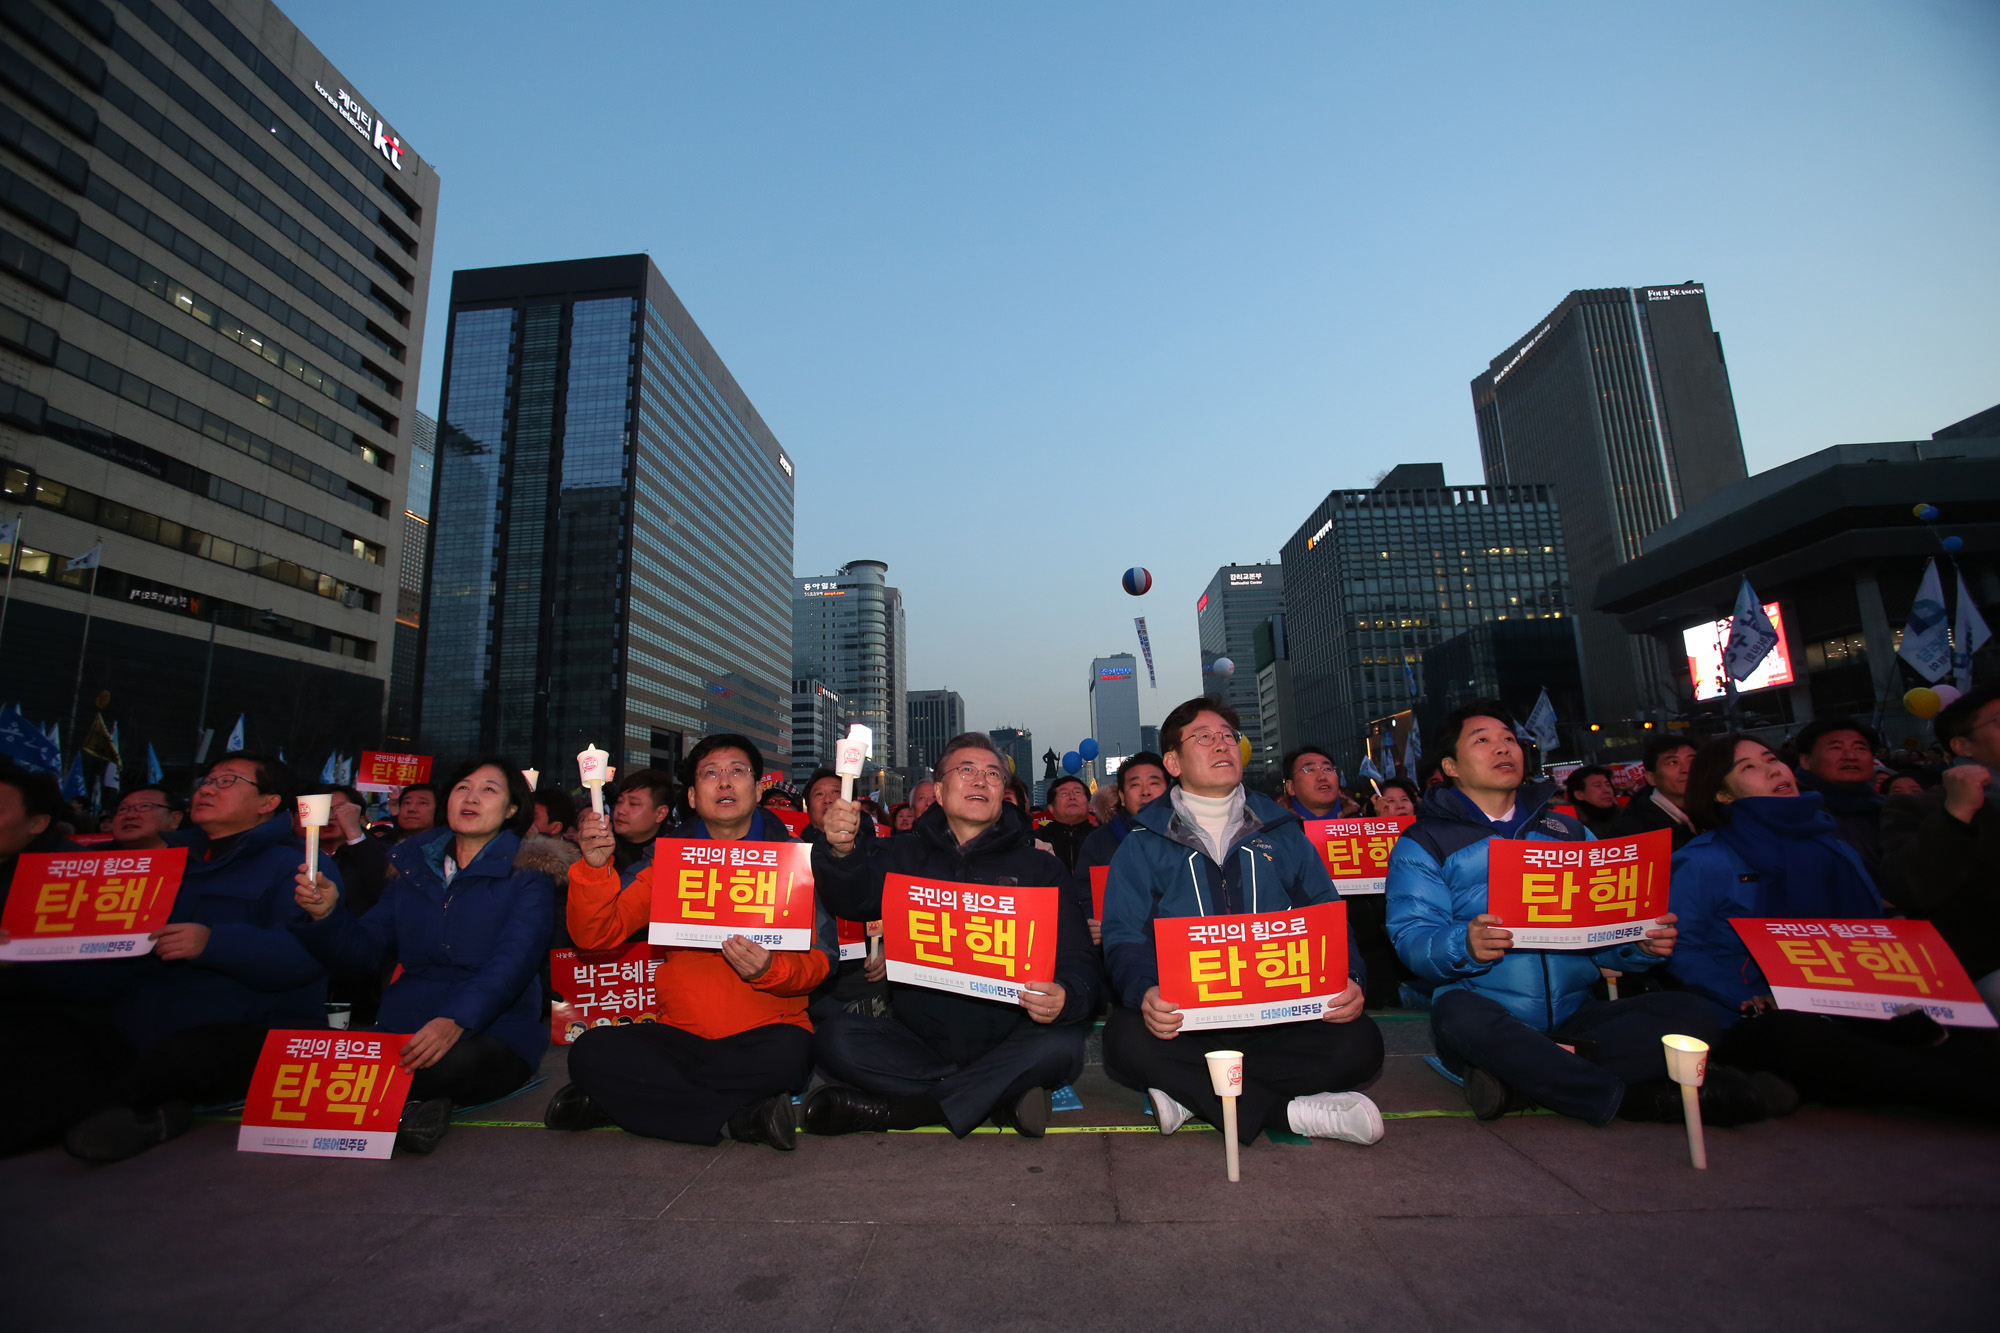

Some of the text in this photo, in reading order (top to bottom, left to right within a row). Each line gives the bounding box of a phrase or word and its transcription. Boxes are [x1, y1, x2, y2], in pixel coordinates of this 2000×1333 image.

[314, 80, 370, 141] korea telecom
[338, 88, 372, 132] 케이티
[373, 120, 404, 171] kt
[1670, 288, 1704, 296] SEASONS
[804, 582, 837, 590] 동아일보
[1230, 572, 1262, 580] 감리교본부
[372, 763, 424, 784] 탄핵!
[1324, 822, 1400, 837] 국민의 힘으로
[48, 857, 152, 878] 국민의 힘으로
[680, 846, 778, 866] 국민의 힘으로
[1523, 844, 1638, 868] 국민의 힘으로
[678, 868, 794, 924] 탄핵!
[908, 885, 1016, 914] 국민의 힘으로
[1522, 862, 1654, 922] 탄핵!
[34, 876, 164, 933] 탄핵!
[1188, 917, 1308, 944] 국민의 힘으로
[1587, 926, 1644, 943] 더불어민주당
[1766, 922, 1896, 939] 국민의 힘으로
[79, 940, 136, 954] 더불어민주당
[908, 910, 1036, 978] 탄핵!
[1189, 934, 1326, 1002] 탄핵!
[1776, 939, 1944, 994] 탄핵!
[1261, 1002, 1322, 1020] 더불어민주당
[286, 1038, 382, 1060] 국민의 힘으로
[271, 1062, 396, 1125] 탄핵!
[312, 1137, 368, 1152] 더불어민주당
